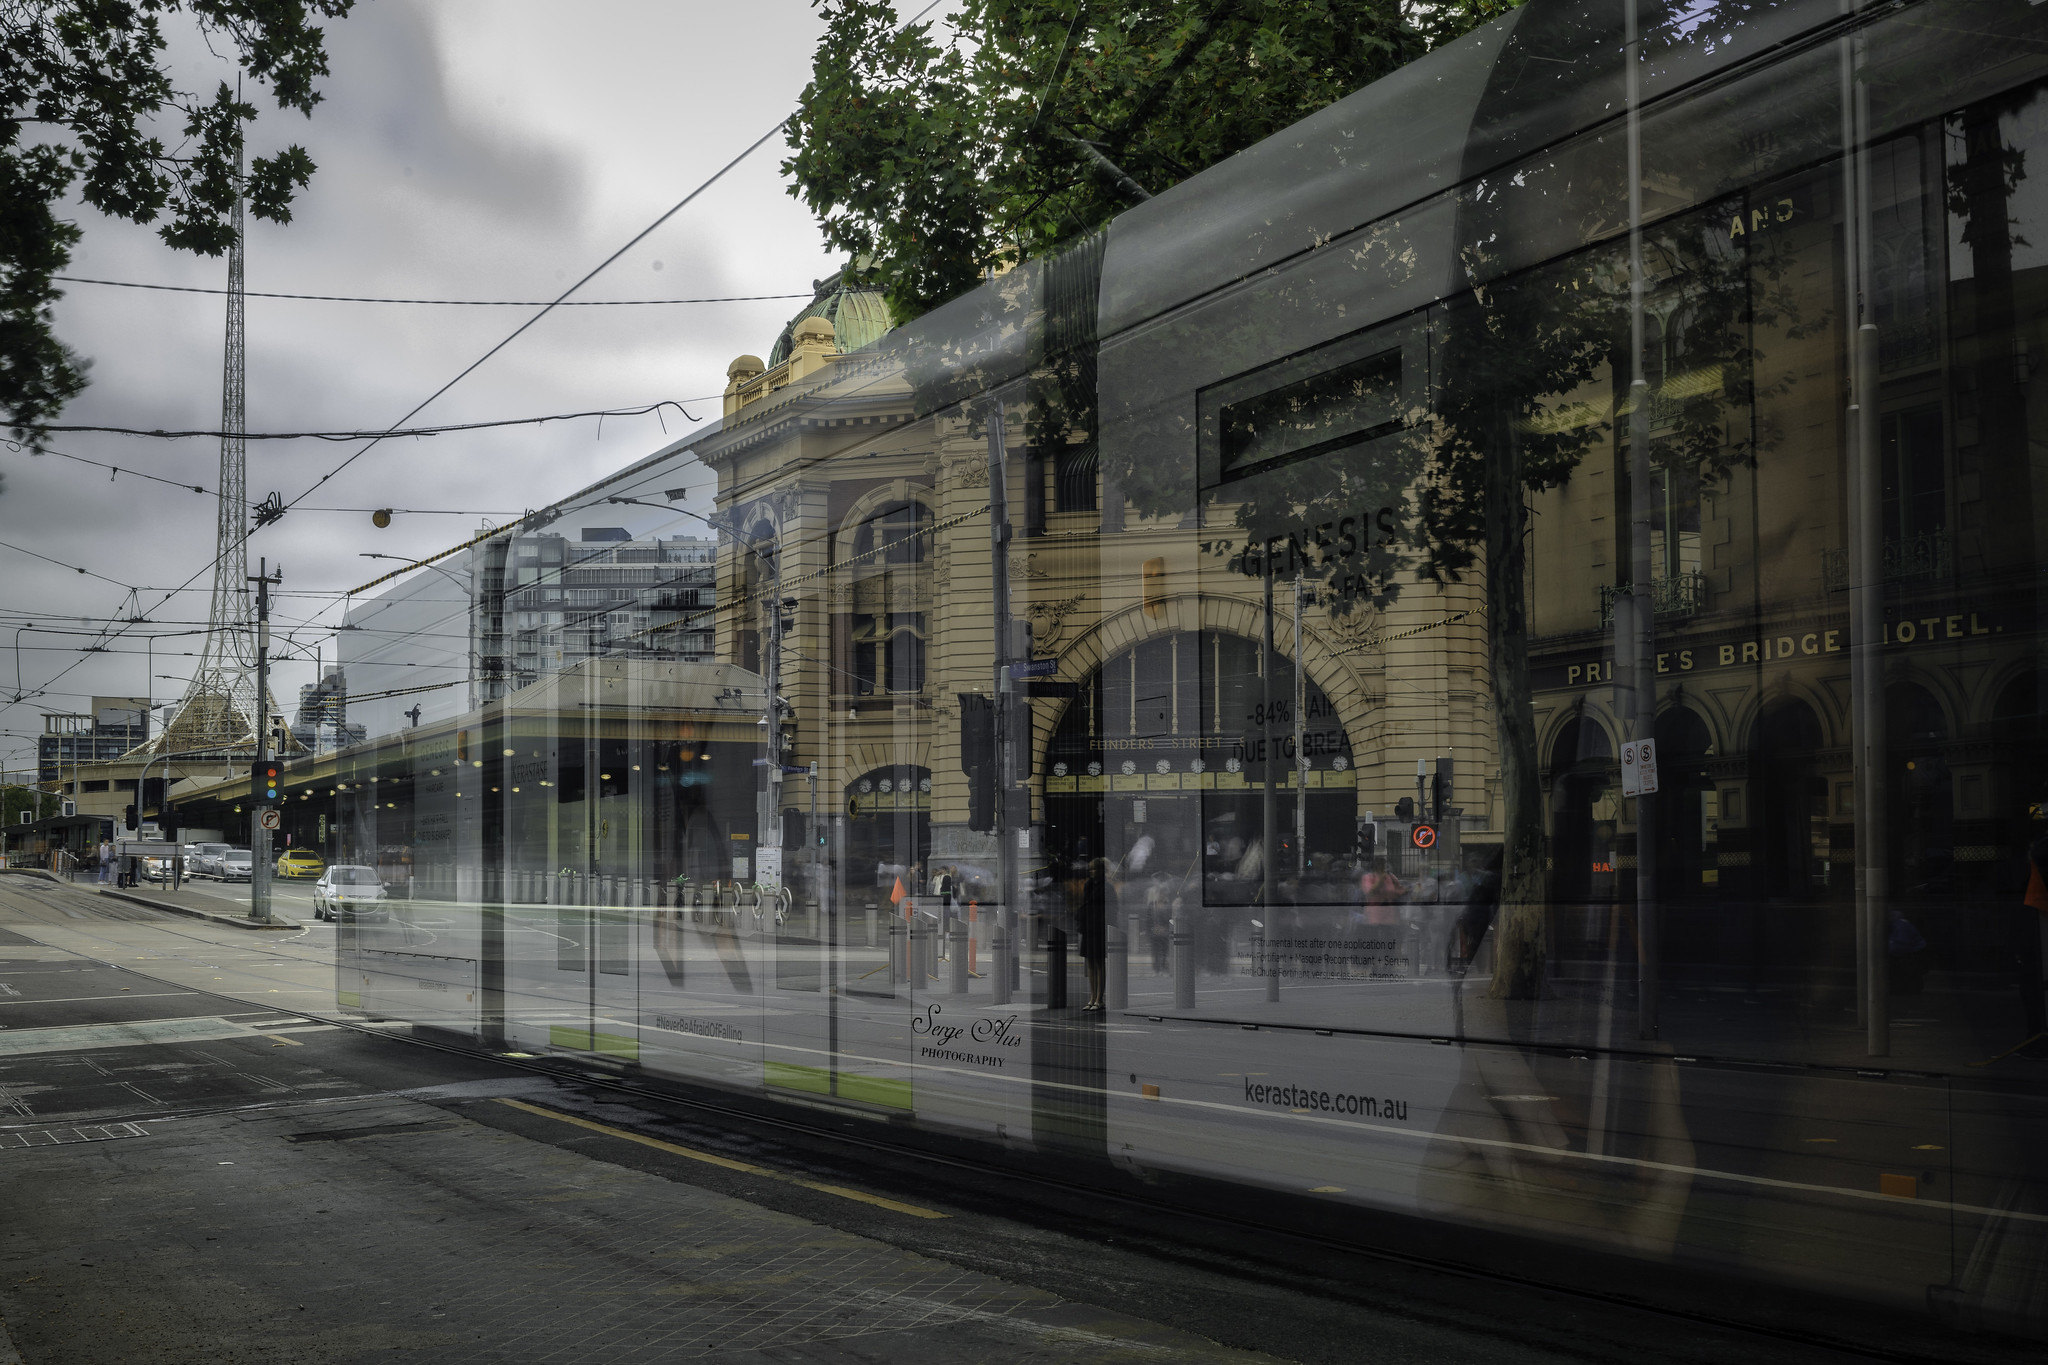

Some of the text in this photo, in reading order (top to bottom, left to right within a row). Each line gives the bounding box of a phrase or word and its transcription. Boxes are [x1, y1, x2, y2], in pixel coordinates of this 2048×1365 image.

[1730, 198, 1793, 240] AND
[1242, 507, 1395, 576] GENESIS
[1023, 661, 1049, 672] Swanston
[1050, 659, 1056, 669] St
[1568, 650, 1694, 685] PRIE'S
[1719, 630, 1841, 666] BRIDGE
[1247, 700, 1290, 726] -84%
[1089, 737, 1222, 751] FLINDERS STREET
[1233, 739, 1267, 763] DUE
[1271, 735, 1297, 760] TO
[1295, 938, 1307, 949] test
[1309, 938, 1326, 949] after
[1328, 940, 1342, 949] one
[1343, 939, 1386, 951] application
[1387, 939, 1396, 950] of
[1295, 953, 1322, 965] Masque
[1323, 953, 1375, 966] Reconstituant
[656, 1014, 743, 1045] #NeverBeAfraidOfFalling
[1244, 1076, 1408, 1121] kerastase.com.au
